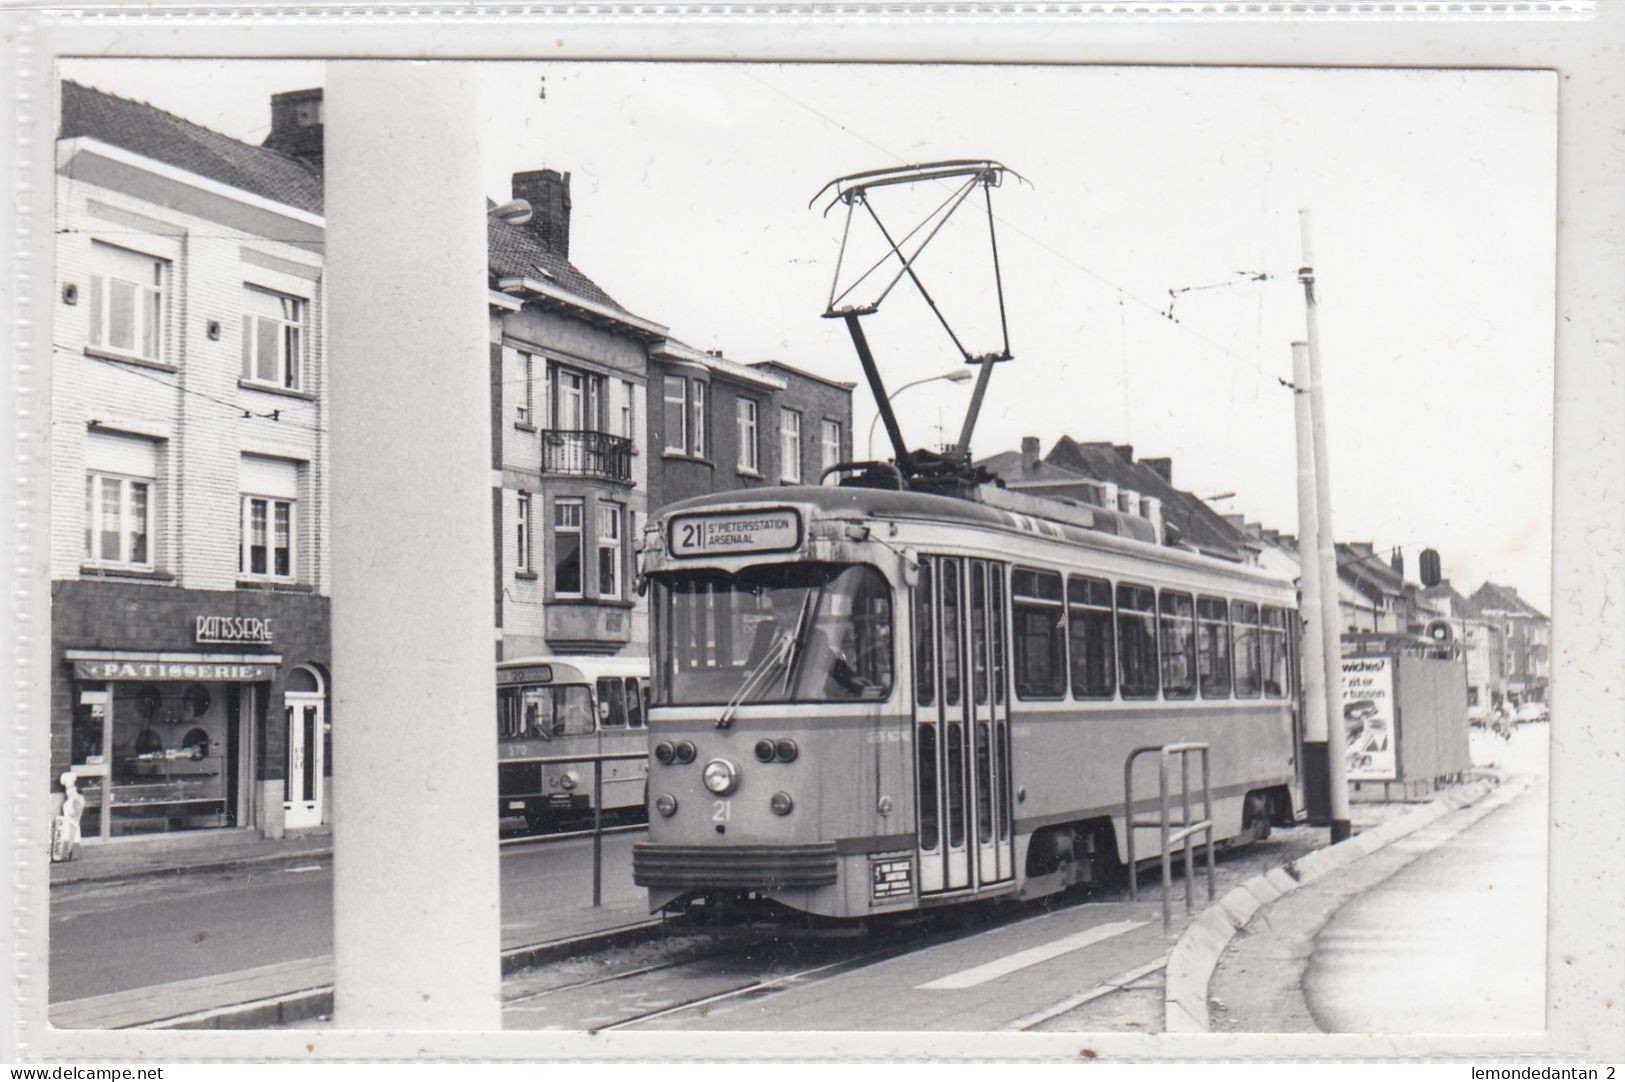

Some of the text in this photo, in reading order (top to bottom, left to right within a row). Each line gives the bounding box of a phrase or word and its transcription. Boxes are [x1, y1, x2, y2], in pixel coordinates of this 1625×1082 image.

[718, 520, 789, 533] PIETERSSTATION
[682, 524, 701, 548] 21
[709, 534, 754, 546] ARSENAAL
[103, 664, 253, 679] PATISSERIE
[1342, 660, 1385, 672] wiches?
[712, 801, 730, 822] 21
